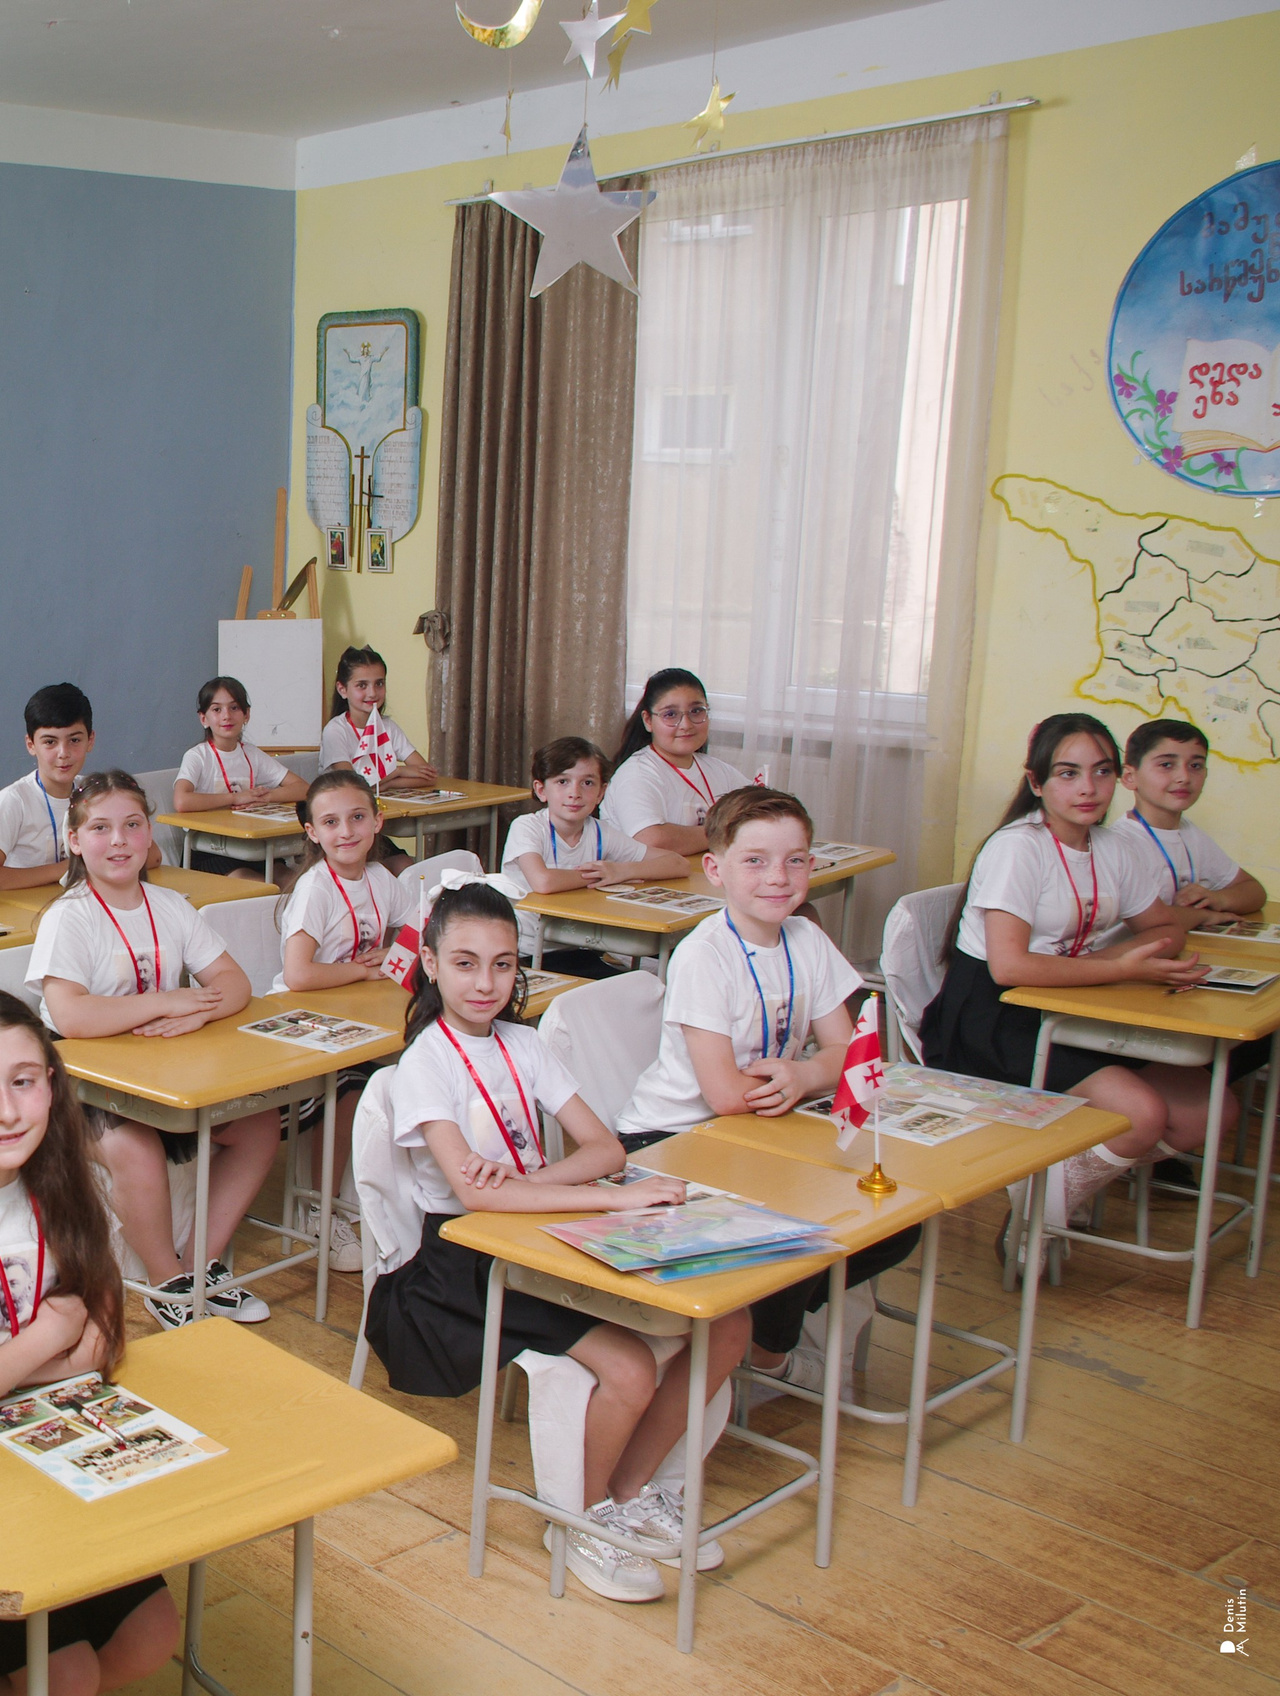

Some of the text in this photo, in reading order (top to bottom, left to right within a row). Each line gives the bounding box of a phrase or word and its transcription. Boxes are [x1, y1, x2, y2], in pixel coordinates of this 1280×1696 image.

[1201, 201, 1280, 245] მამუ
[1188, 362, 1262, 389] დედა
[1192, 382, 1239, 419] ენა
